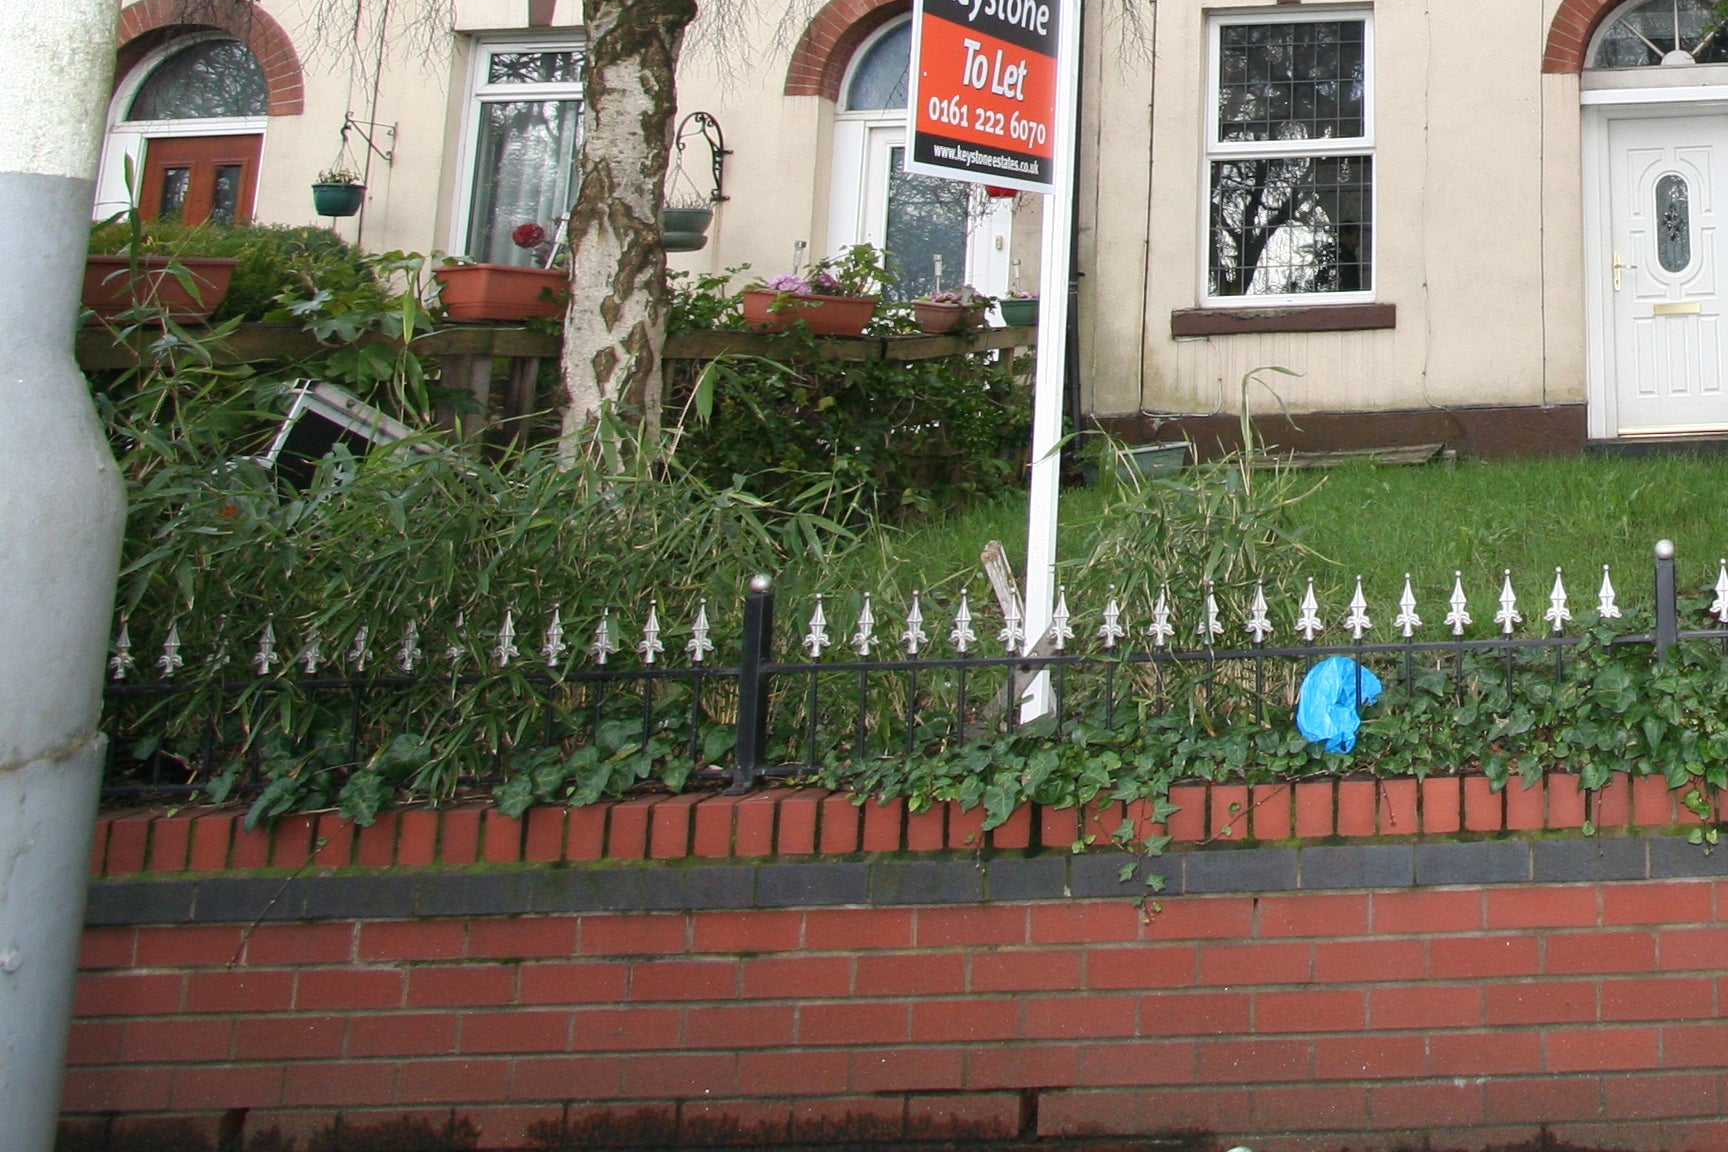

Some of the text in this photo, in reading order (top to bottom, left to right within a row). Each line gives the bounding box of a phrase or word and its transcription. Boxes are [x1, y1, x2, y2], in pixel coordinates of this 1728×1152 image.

[963, 38, 1028, 102] To Let
[928, 94, 1046, 149] 0161 222 6070
[933, 143, 1040, 175] www.keystoneestates.co.uk
